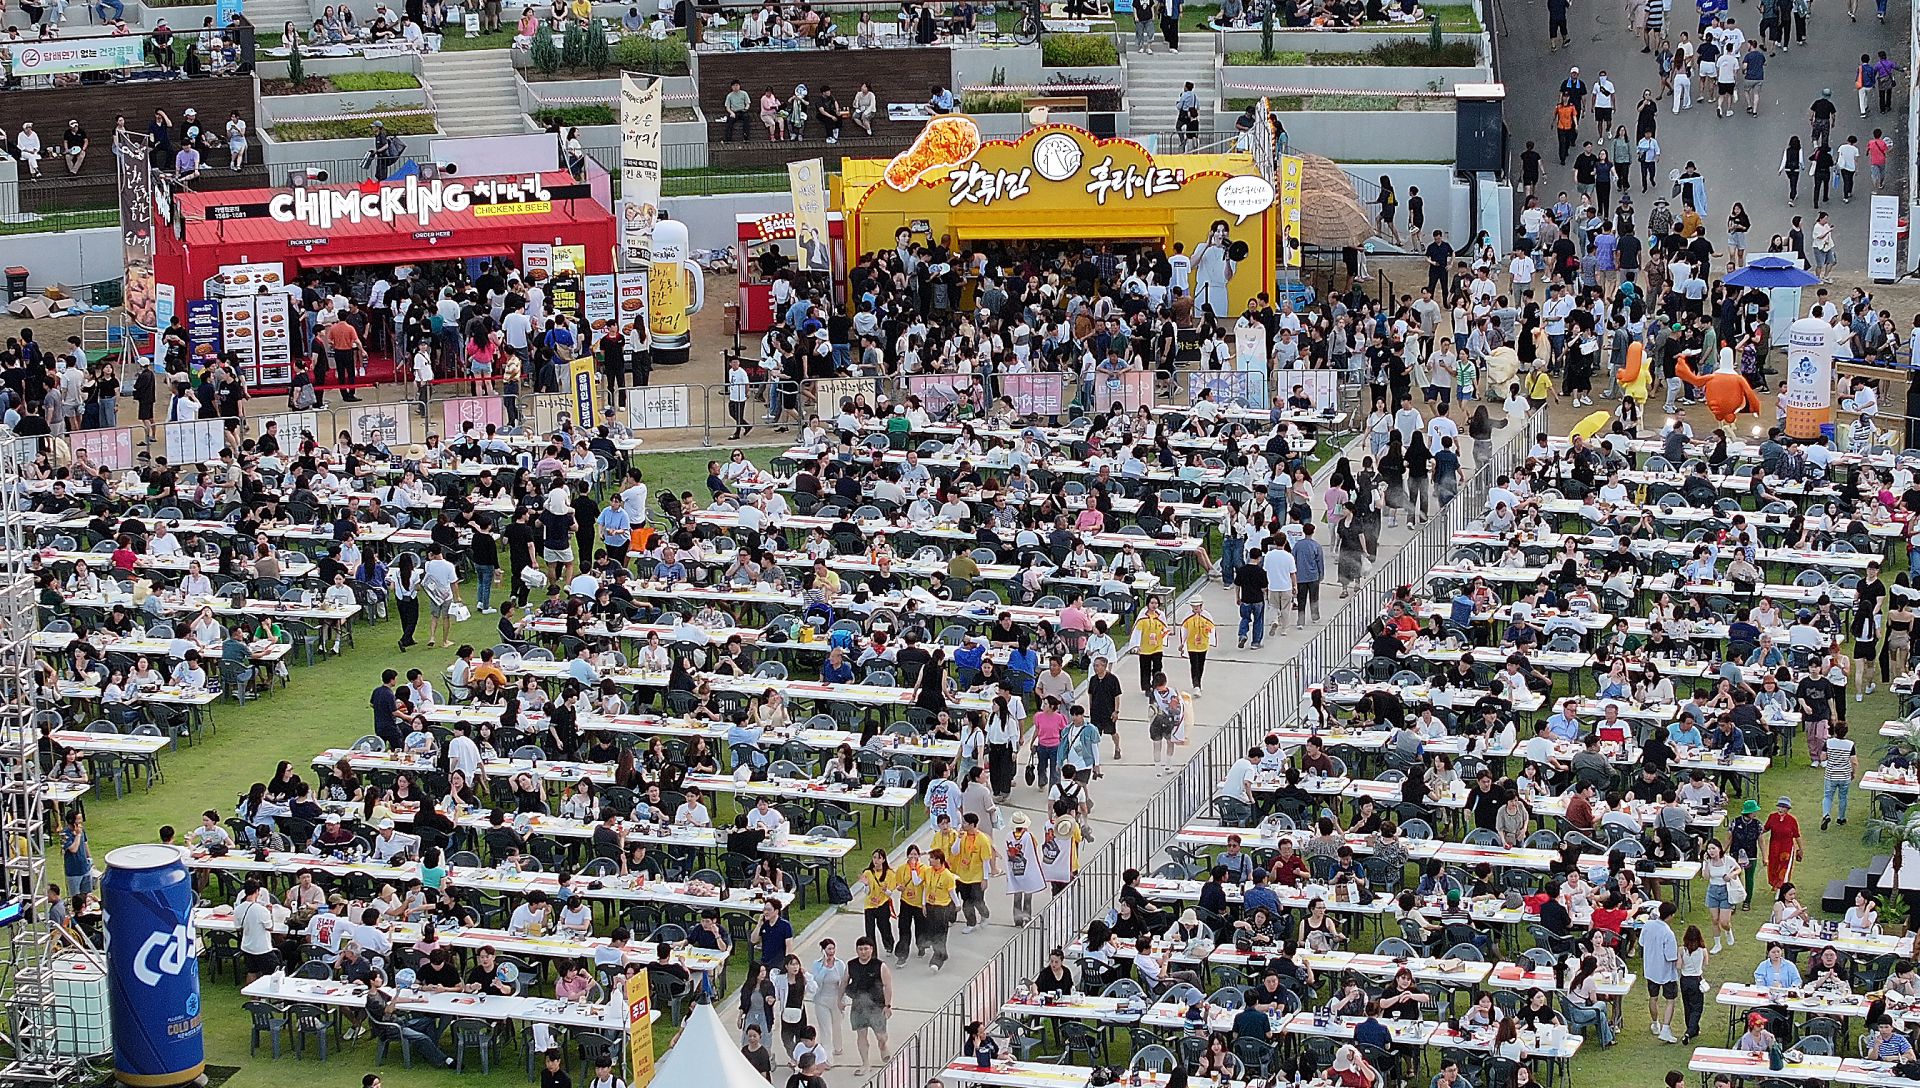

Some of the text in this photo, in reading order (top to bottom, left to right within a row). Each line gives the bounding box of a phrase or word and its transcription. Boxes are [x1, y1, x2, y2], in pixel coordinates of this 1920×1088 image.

[80, 49, 97, 58] 없는
[99, 45, 134, 57] 건강공원
[624, 168, 634, 180] 킨
[636, 170, 642, 178] &
[949, 155, 1181, 207] 갓튀긴 후라이드
[475, 203, 550, 214] CHICKEN & BEER
[632, 999, 646, 1019] 주의
[168, 1021, 189, 1036] COLD
